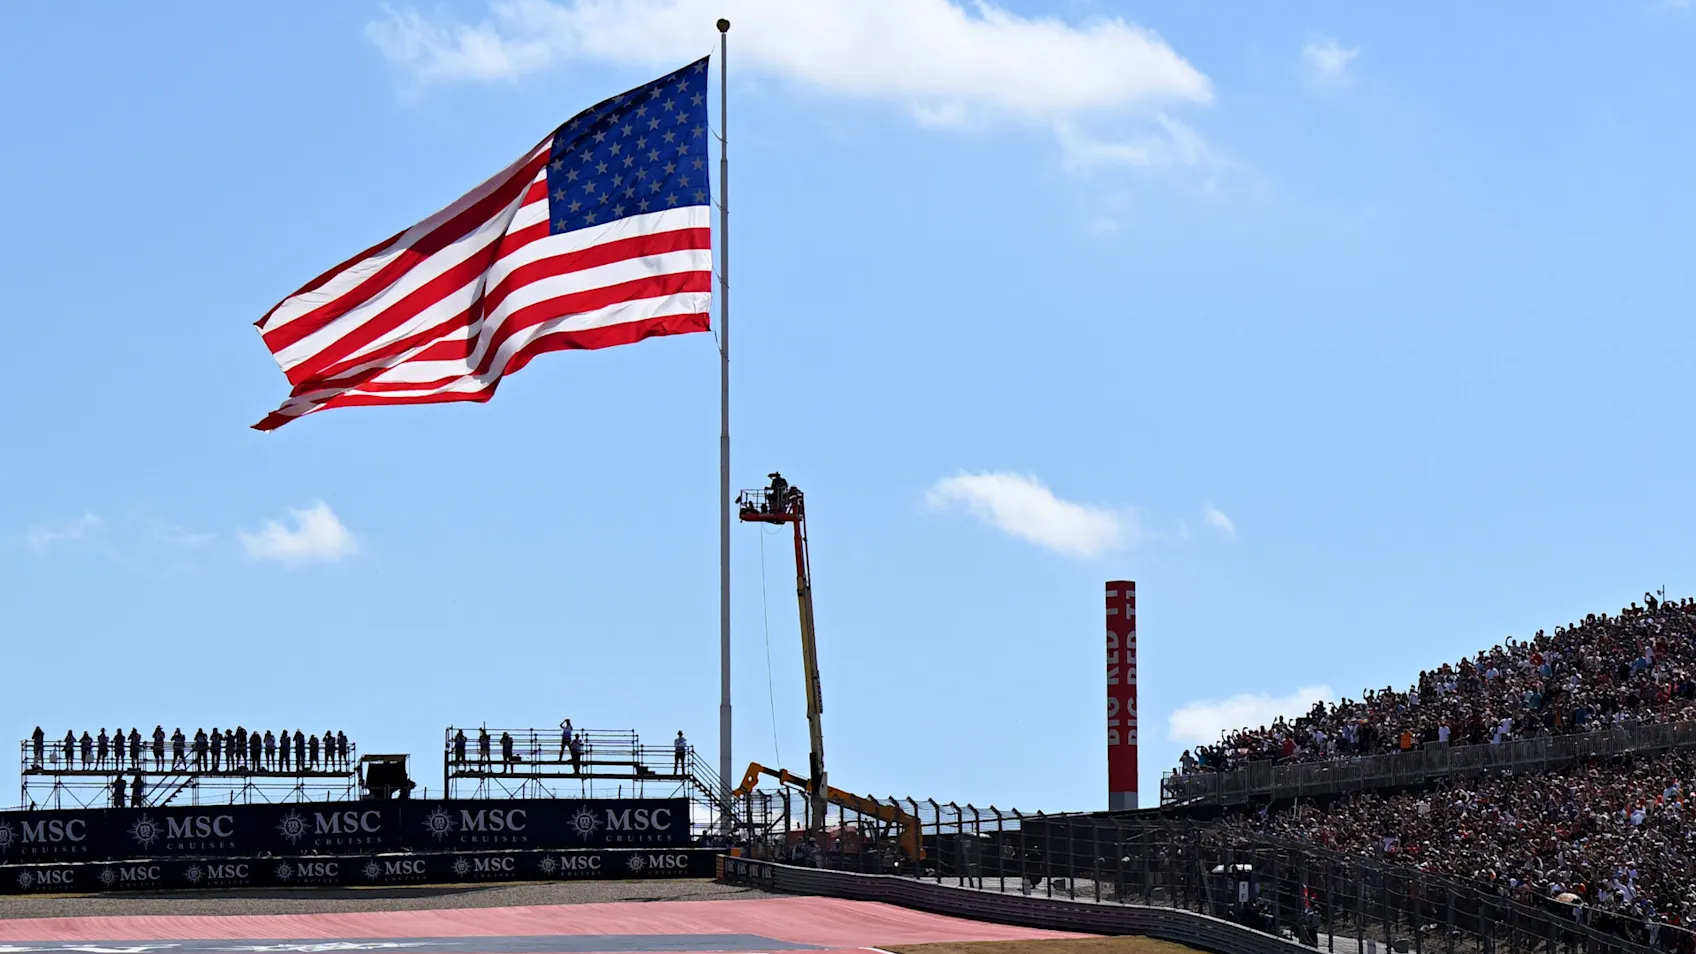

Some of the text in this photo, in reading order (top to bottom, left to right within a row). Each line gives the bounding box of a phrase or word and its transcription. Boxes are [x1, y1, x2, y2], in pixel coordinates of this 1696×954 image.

[166, 814, 234, 839] MSC
[313, 810, 381, 834] MSC
[459, 808, 527, 832] MSC
[605, 808, 671, 831] MSC
[20, 818, 87, 843] MSC
[605, 834, 672, 843] CRUISES
[166, 841, 235, 850] CRUISES
[314, 836, 382, 846] CRUISES
[460, 835, 528, 844] CRUISES
[297, 862, 339, 877] MSC
[384, 859, 426, 875] MSC
[473, 856, 515, 872] MSC
[560, 855, 601, 870] MSC
[648, 854, 688, 869] MSC
[36, 869, 74, 885] MSC
[119, 865, 161, 881] MSC
[207, 863, 249, 879] MSC
